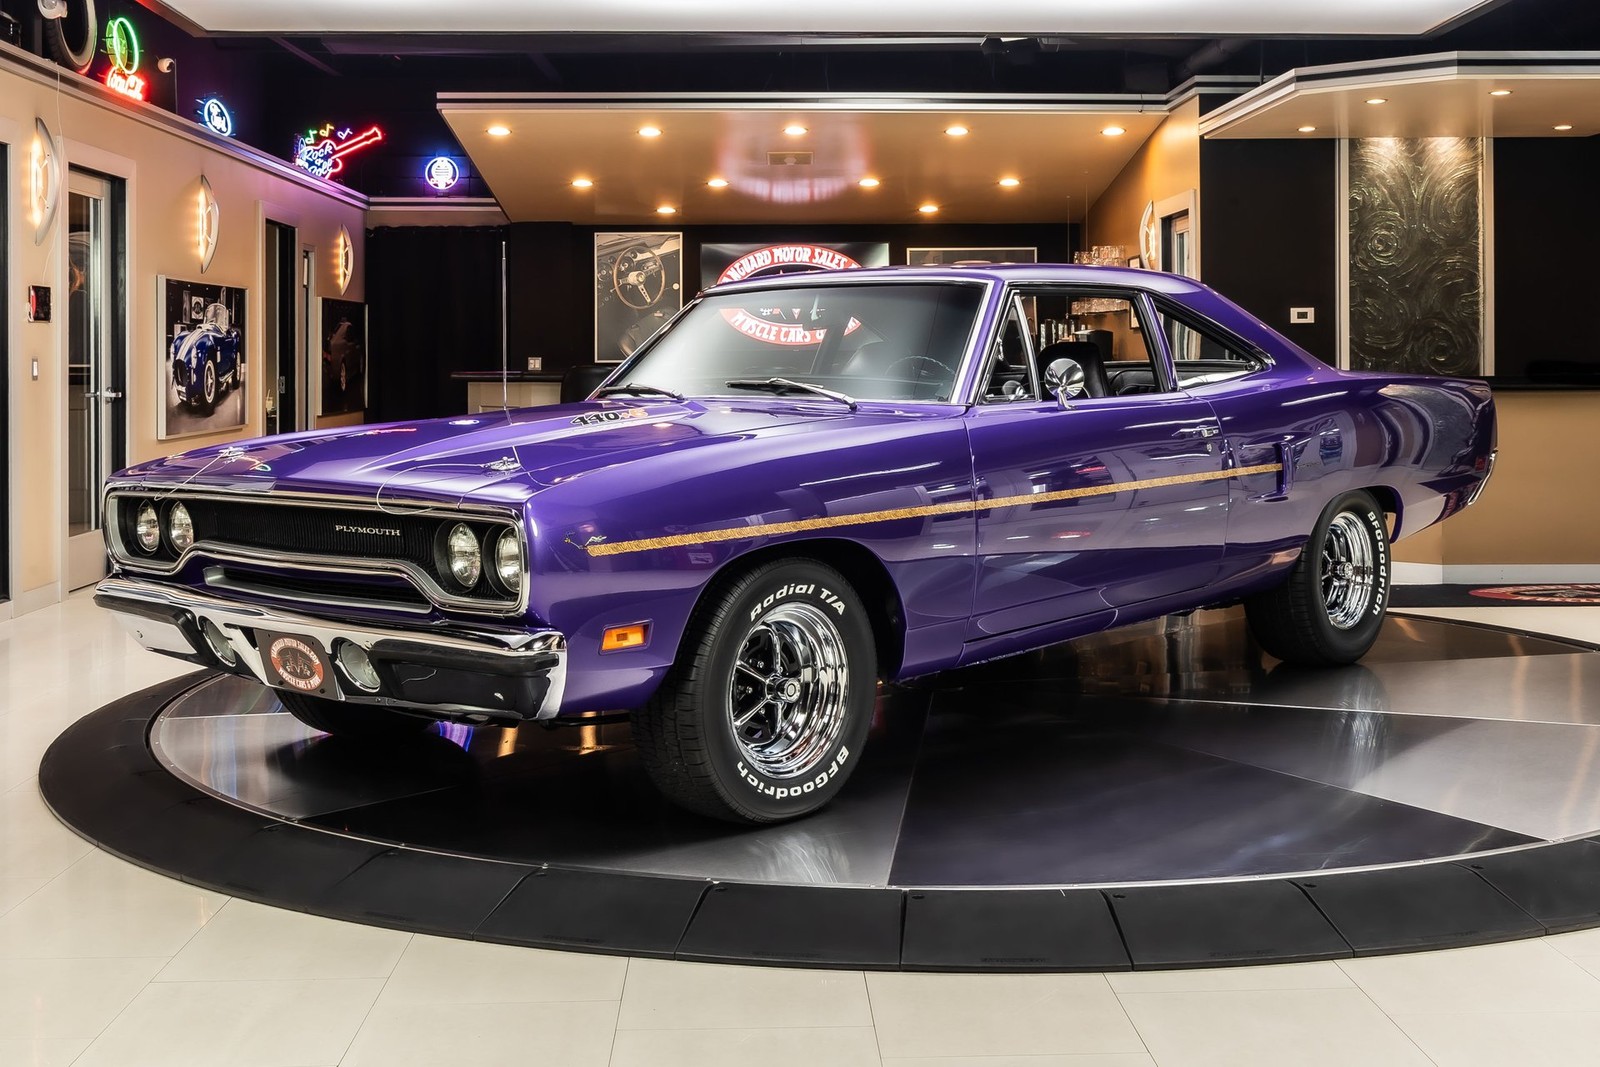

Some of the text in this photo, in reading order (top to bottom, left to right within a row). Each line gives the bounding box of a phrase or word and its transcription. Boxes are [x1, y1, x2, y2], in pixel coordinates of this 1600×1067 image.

[304, 141, 333, 161] Rock
[721, 250, 772, 284] ANGUARD
[772, 246, 811, 263] MOTOR
[731, 311, 779, 341] MUSCLE
[780, 327, 811, 343] CARS
[335, 524, 401, 537] PLYMOUTH
[1367, 511, 1387, 616] BFGoodrich
[750, 583, 846, 622] Radial T/A
[737, 745, 850, 800] BFGoodrich
